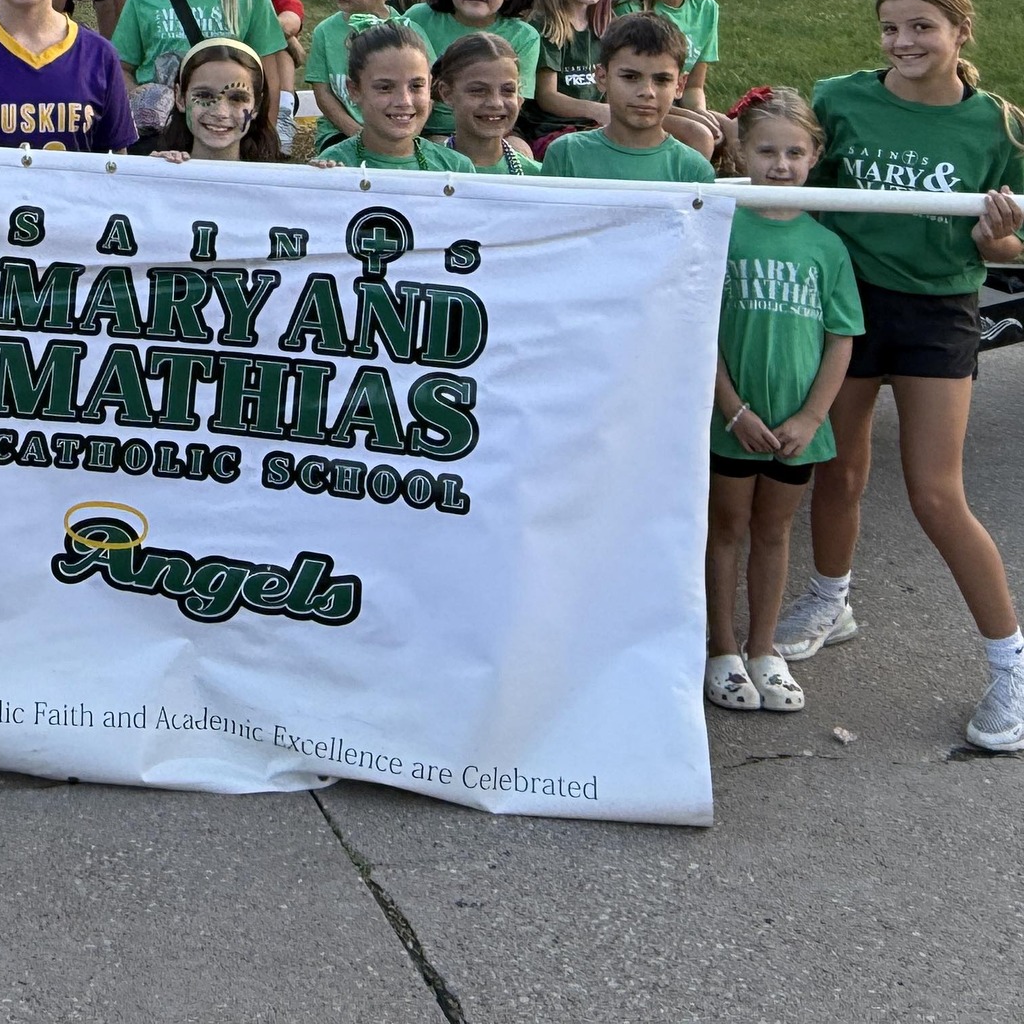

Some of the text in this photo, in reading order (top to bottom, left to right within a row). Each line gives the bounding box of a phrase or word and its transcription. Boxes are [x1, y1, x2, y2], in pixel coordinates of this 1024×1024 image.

[843, 156, 924, 189] MARY
[922, 162, 961, 193] &
[279, 272, 488, 369] AND
[262, 450, 470, 515] SCHOOL
[51, 516, 362, 626] Angels
[33, 701, 94, 728] Faith
[102, 705, 147, 729] and
[155, 706, 264, 742] Academic
[273, 725, 403, 775] Excellence
[411, 760, 453, 785] are
[462, 765, 598, 800] Celebrated
